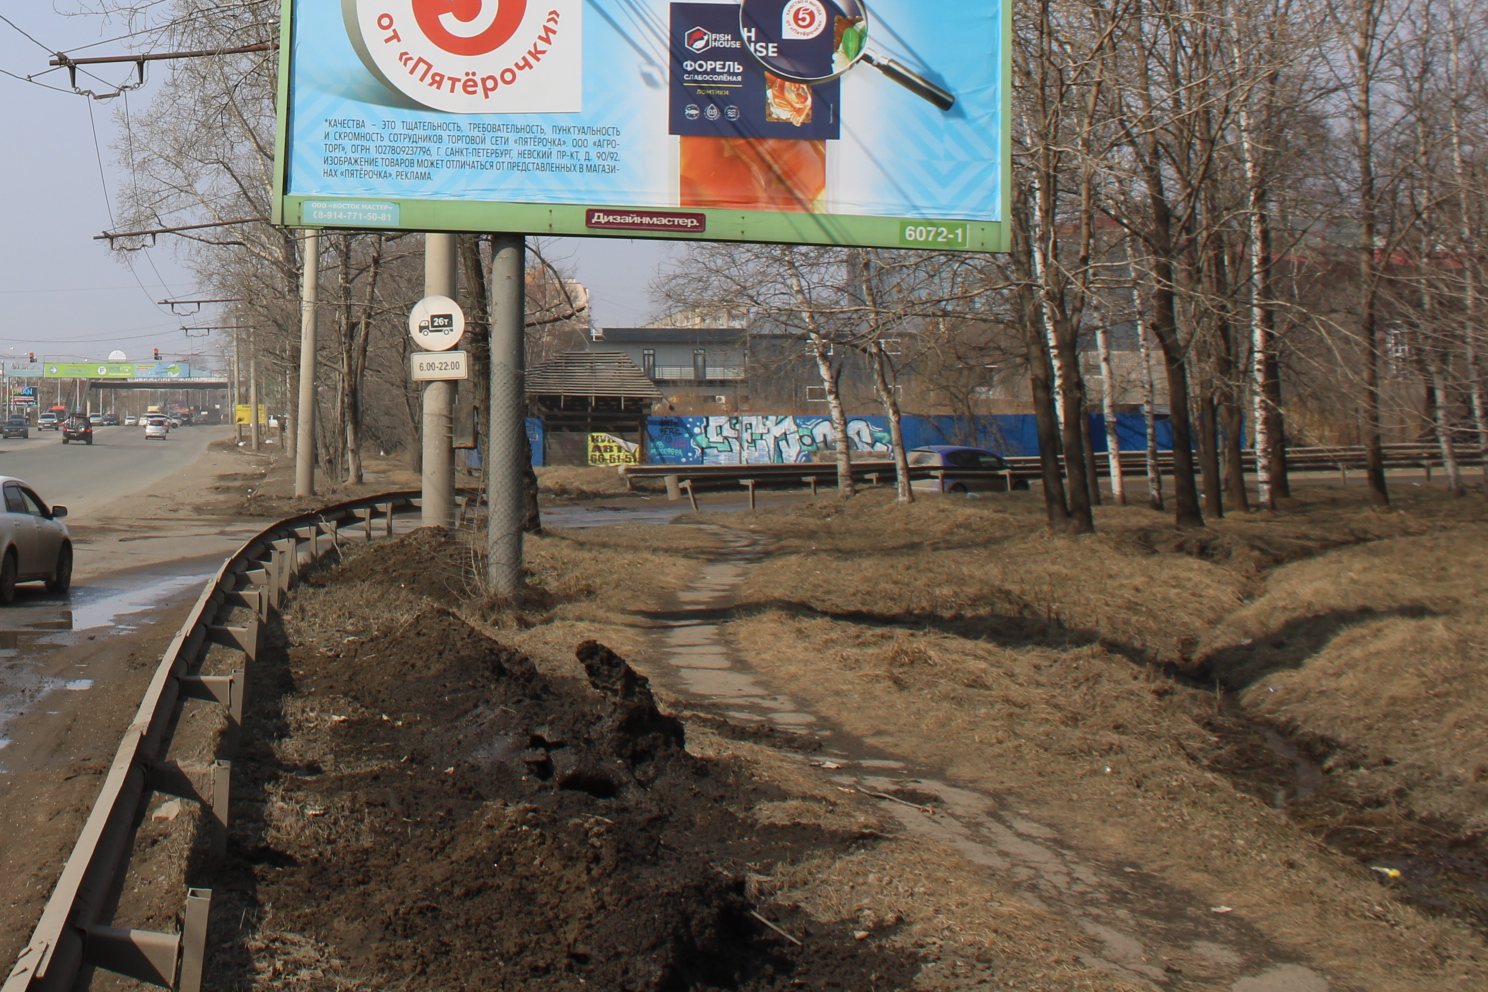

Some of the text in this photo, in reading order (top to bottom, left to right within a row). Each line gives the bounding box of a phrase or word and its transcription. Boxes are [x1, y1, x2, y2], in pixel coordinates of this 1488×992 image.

[712, 41, 742, 49] HOUSE
[398, 9, 561, 100] «Пятёрочки»
[682, 60, 744, 73] ФОРЕЛЬ
[382, 120, 396, 130] ЭТО
[402, 120, 463, 132] ТЩАТЕЛЬНОСТЬ,
[468, 122, 546, 135] ТРЕБОВАТЕЛЬНОСТЬ,
[552, 125, 620, 137] ПУНКТУАЛЬНОСТЬ
[324, 131, 330, 141] И
[334, 131, 385, 142] СКРОМНОСТЬ
[388, 133, 443, 144] СОТРУДНИКОВ
[447, 134, 486, 145] ТОРГОВОЙ
[490, 135, 509, 146] СЕТИ
[572, 138, 588, 148] ООО
[592, 138, 620, 149] «АГРО-
[324, 143, 347, 155] ТОРГ»,
[351, 144, 370, 154] ОГРН
[445, 146, 514, 159] САНКТ-ПЕТЕРБУРГ,
[517, 148, 552, 159] НЕВСКИЙ
[556, 150, 580, 162] ПР-КТ,
[323, 156, 620, 174] ИЗОБРАЖЕНИЕ ТОВАРОВ МОЖЕТ ОТЛИЧАТЬСЯ ОТ ПРЕДСТАВЛЕННЫХ В МАГАЗИ-
[323, 169, 338, 178] НАХ
[395, 170, 434, 181] РЕКЛАМА.
[591, 212, 700, 228] Дизайнмастер.
[904, 225, 964, 244] 6072-1
[419, 360, 460, 372] 6.00-22.00
